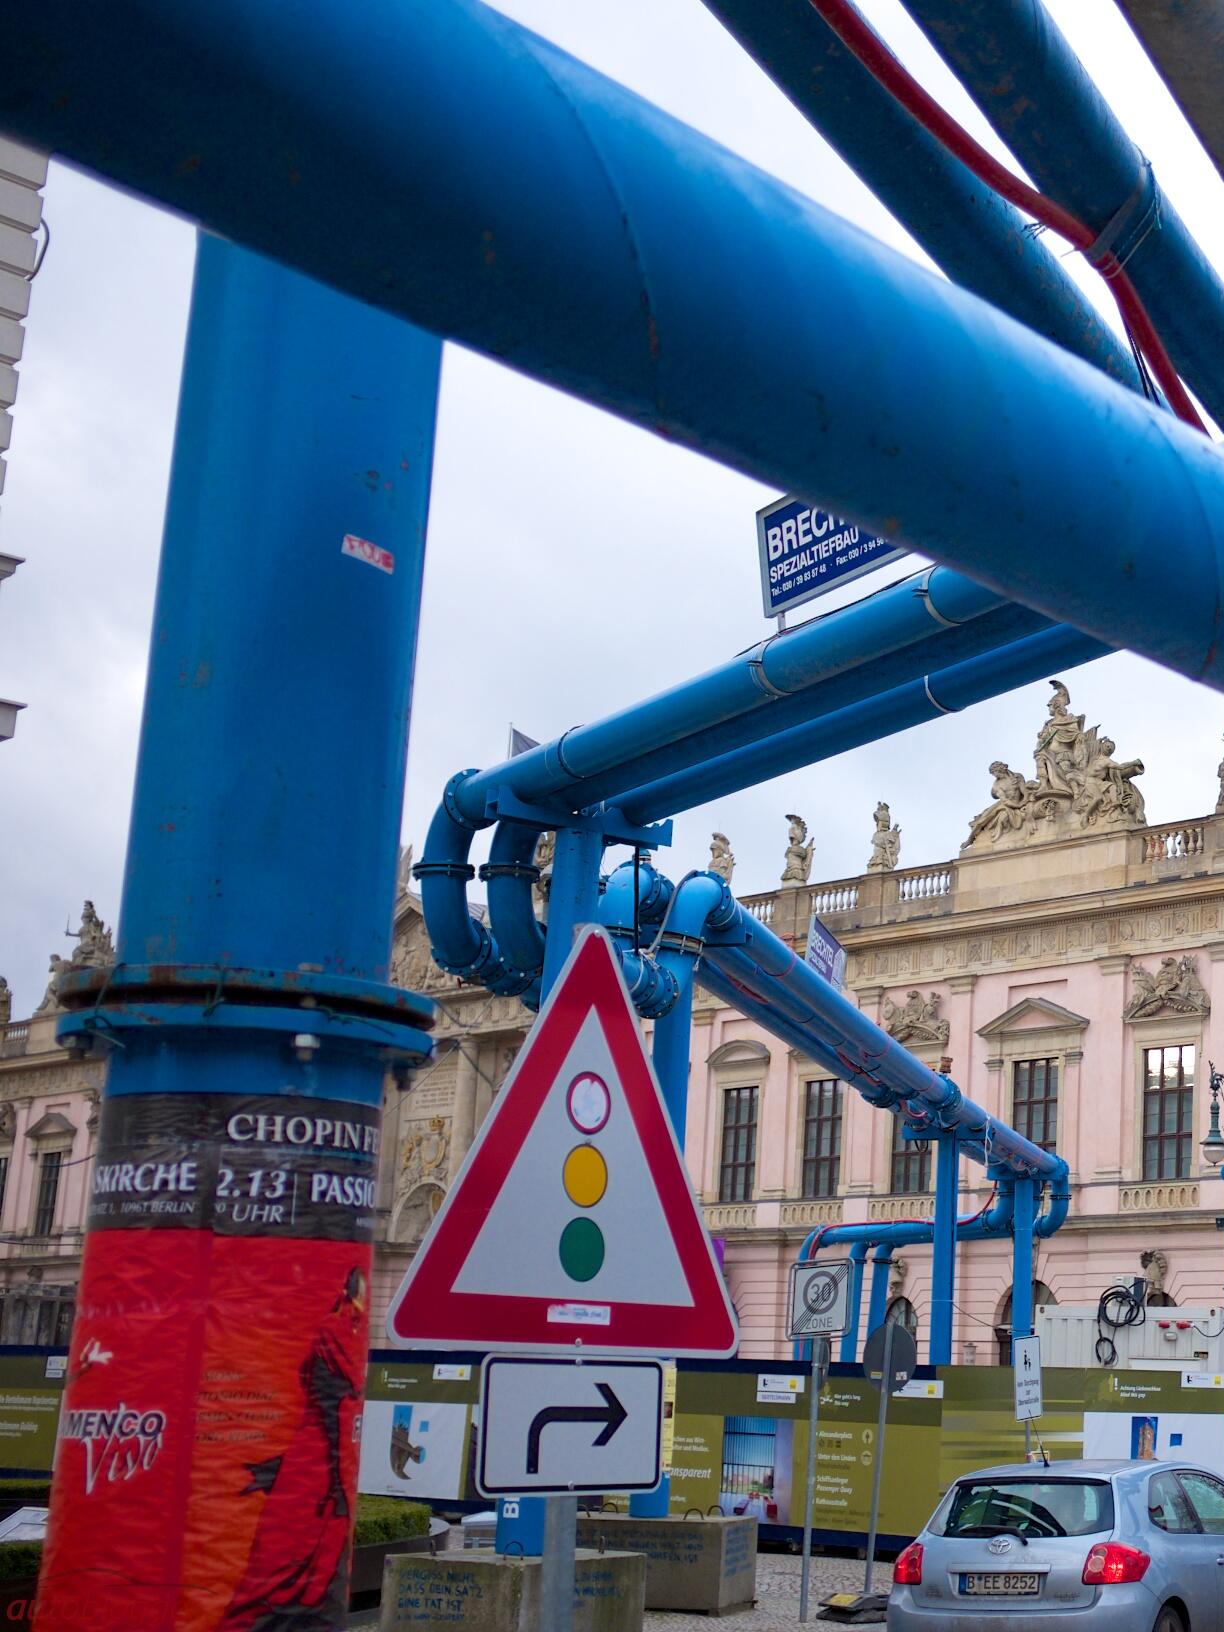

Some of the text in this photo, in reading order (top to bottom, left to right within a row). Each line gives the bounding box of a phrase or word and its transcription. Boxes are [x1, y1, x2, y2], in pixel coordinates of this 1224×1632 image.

[770, 526, 860, 584] SPEZIALTIEFBAU
[227, 1114, 361, 1150] CHOPIN
[151, 1201, 197, 1214] BERLIN
[232, 1204, 285, 1223] UHR
[805, 1317, 833, 1330] ZONE
[967, 1576, 1036, 1590] B EE 8252
[455, 1584, 483, 1599] SATZ
